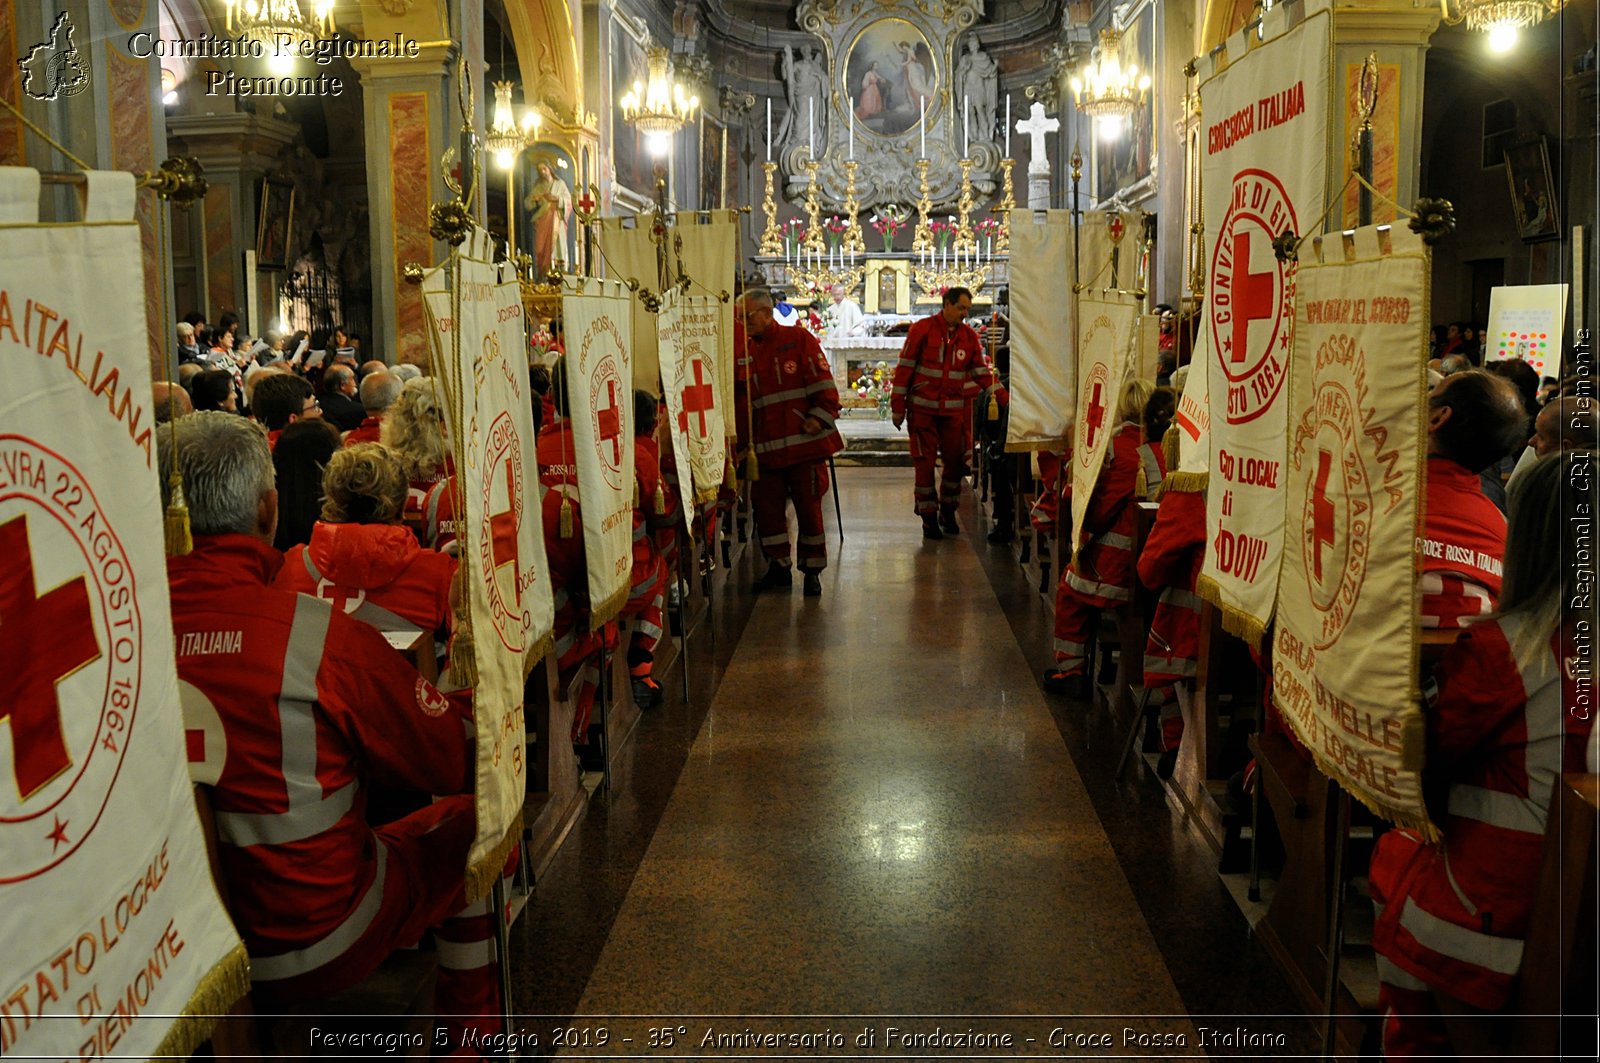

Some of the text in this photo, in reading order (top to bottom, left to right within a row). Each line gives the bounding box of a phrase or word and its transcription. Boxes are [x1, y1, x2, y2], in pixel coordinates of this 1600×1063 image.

[1257, 80, 1305, 132] ITALIANA
[1251, 181, 1271, 214] DI
[1251, 354, 1282, 406] 1864
[1238, 457, 1279, 489] LOCALE
[1344, 451, 1362, 489] 22
[51, 471, 83, 519] 22
[1222, 489, 1233, 517] di
[1341, 499, 1368, 606] AGOSTO
[1446, 544, 1475, 567] ROSSA
[1476, 552, 1504, 578] ITALIAN
[80, 510, 135, 664] AGOSTO
[180, 630, 243, 657] ITALIANA
[102, 676, 132, 754] 1864
[1322, 723, 1401, 799] LOCALE
[100, 836, 170, 953] LOCALE
[76, 983, 102, 1026] DI
